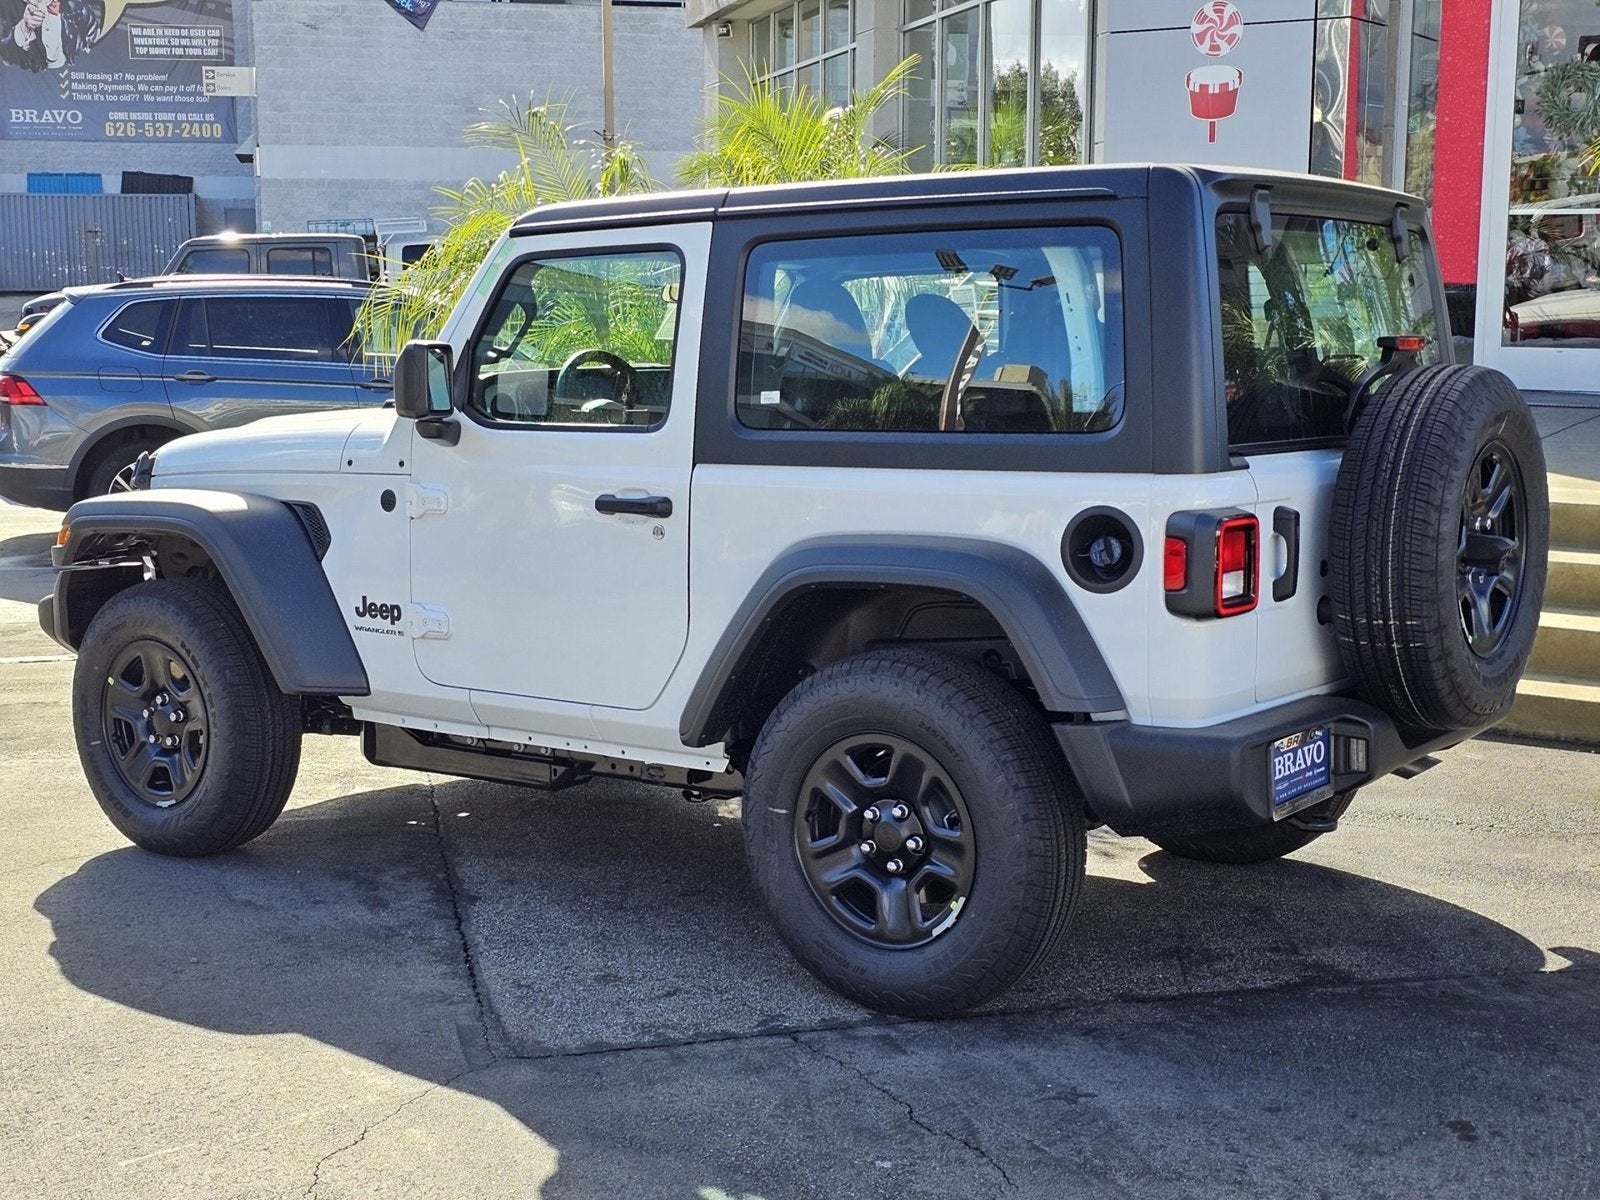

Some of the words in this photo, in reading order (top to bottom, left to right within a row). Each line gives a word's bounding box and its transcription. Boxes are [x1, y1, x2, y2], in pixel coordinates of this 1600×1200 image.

[156, 28, 163, 36] IN
[163, 28, 180, 36] NEED
[207, 29, 220, 37] CAR
[180, 38, 190, 46] WE
[149, 47, 171, 55] MONEY
[172, 47, 184, 55] FOR
[70, 72, 85, 80] Still
[86, 72, 112, 81] leasing
[113, 72, 123, 80] it?
[71, 82, 97, 92] Making
[99, 83, 136, 92] Payments,
[165, 85, 177, 93] pay
[186, 84, 195, 92] off
[93, 93, 104, 101] it's
[144, 94, 155, 102] We
[196, 95, 209, 103] too!
[9, 109, 82, 124] BRAVO
[109, 112, 129, 120] COME
[130, 112, 153, 120] INSIDE
[154, 112, 176, 121] TODAY
[177, 113, 187, 121] OR
[188, 113, 205, 121] CALL
[205, 113, 215, 121] US
[105, 121, 222, 137] 626-537-2400
[355, 596, 402, 625] Jeep
[354, 625, 397, 636] WRANGLER
[1274, 741, 1325, 780] BRAVO
